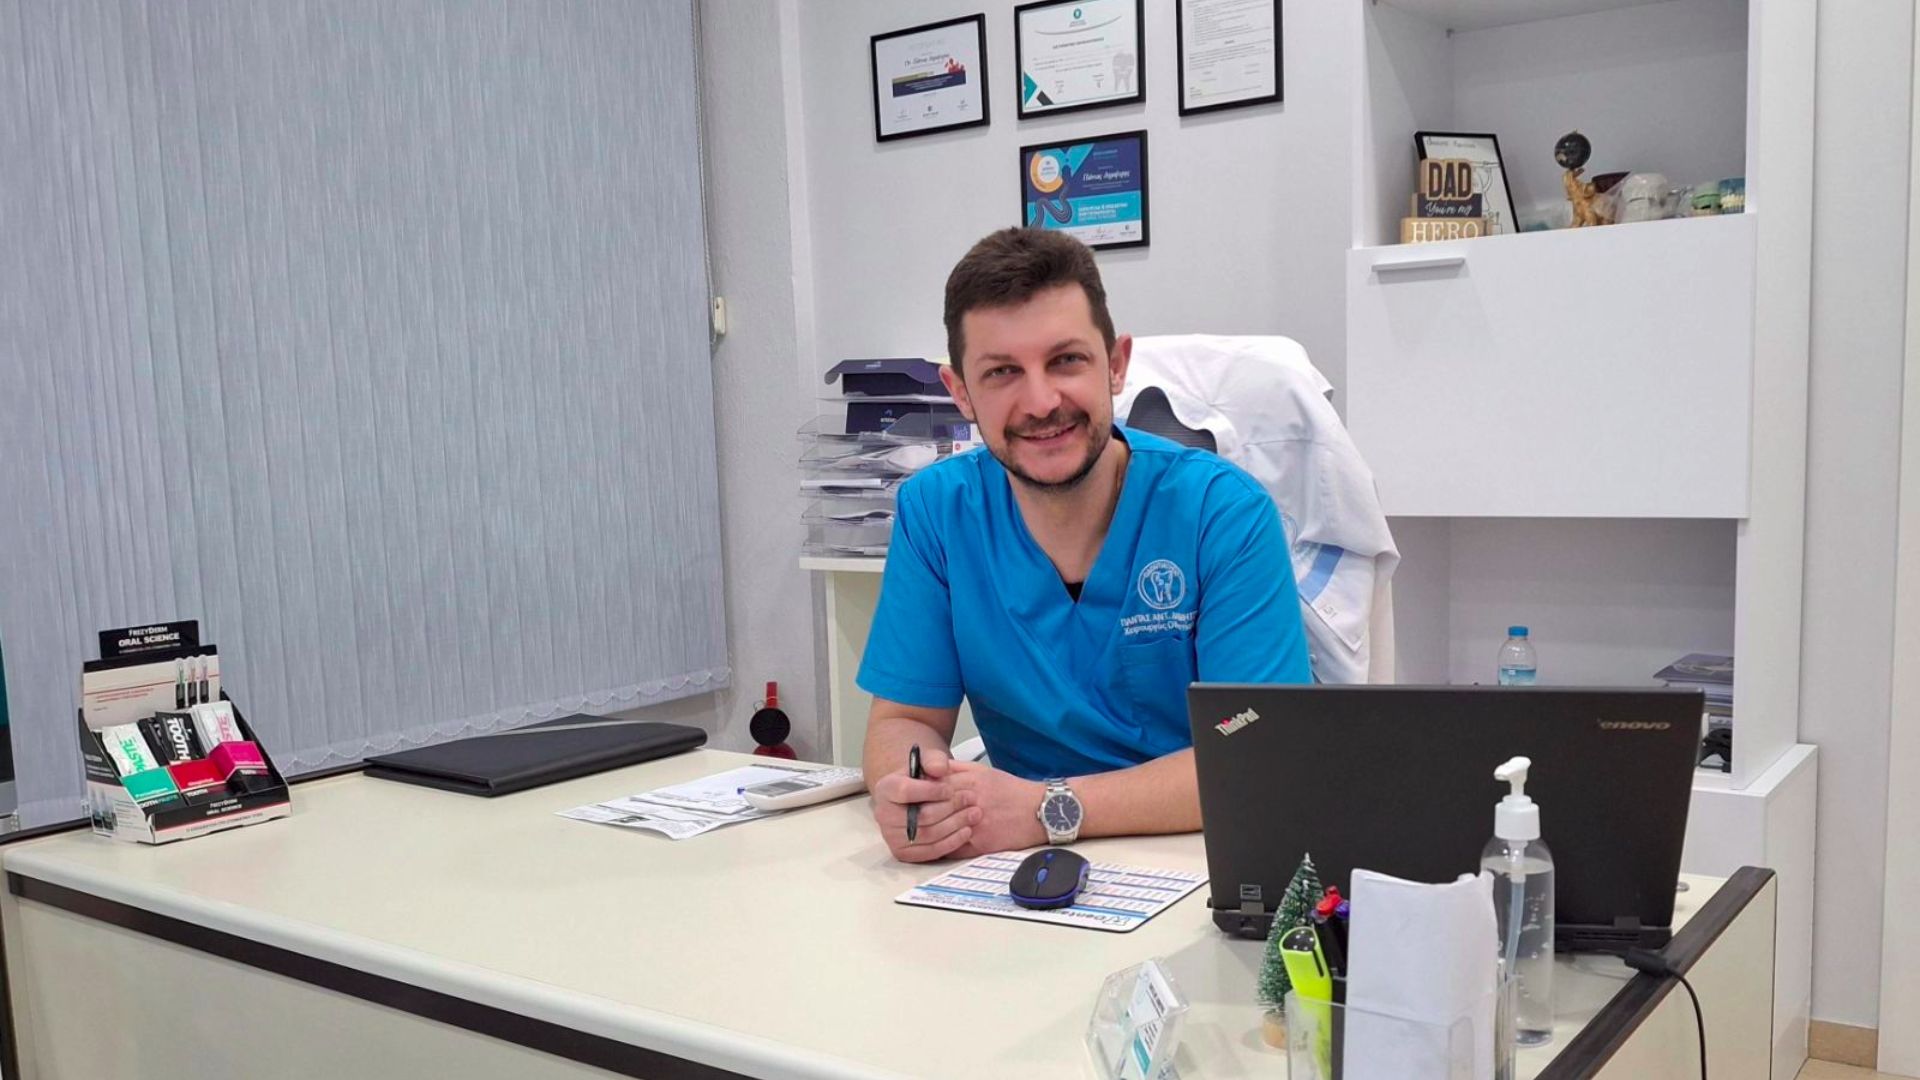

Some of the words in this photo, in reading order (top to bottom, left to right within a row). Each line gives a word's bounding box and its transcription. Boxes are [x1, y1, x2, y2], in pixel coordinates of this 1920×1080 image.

[1428, 162, 1472, 198] DAD
[1411, 221, 1479, 242] HERO
[118, 637, 143, 648] ORAL
[144, 632, 181, 645] SCIENCE
[1214, 707, 1260, 737] ThinkPad
[1597, 719, 1671, 730] enovo
[166, 717, 192, 761] TOOTH
